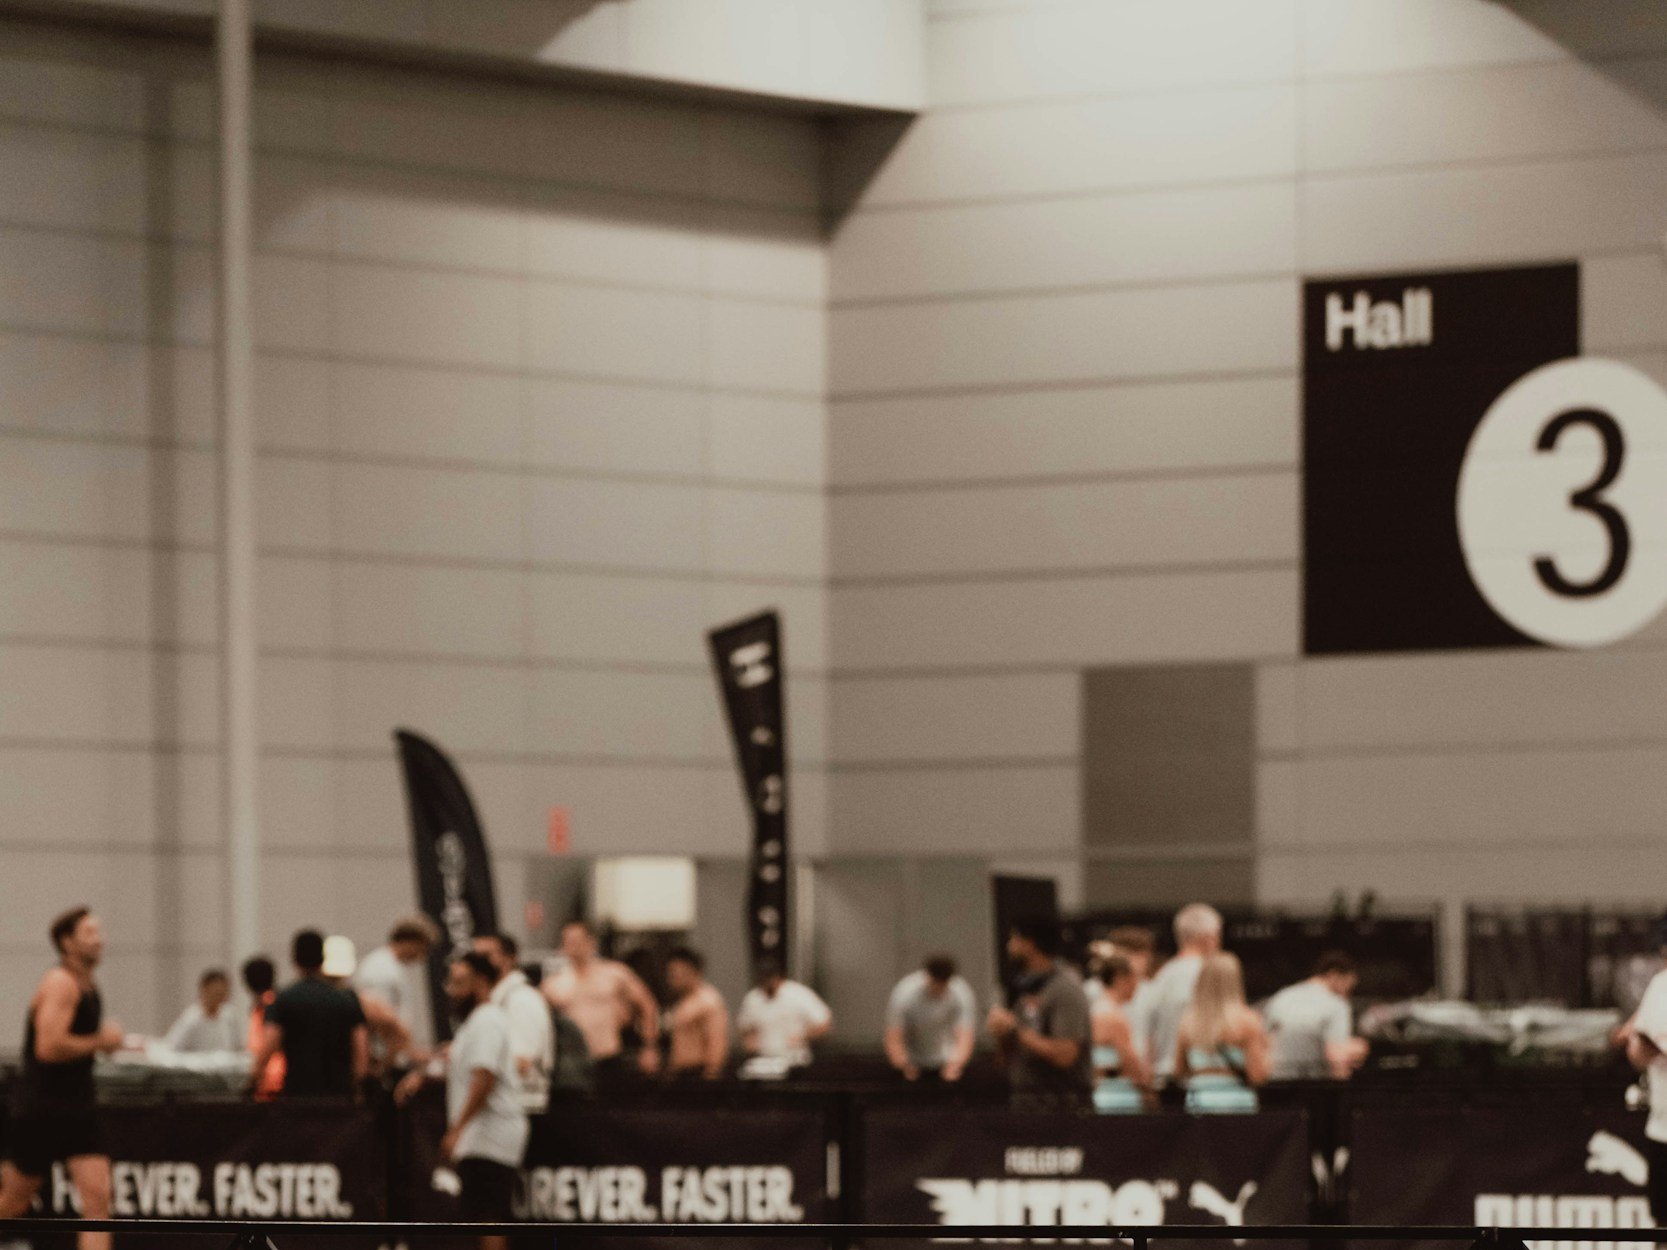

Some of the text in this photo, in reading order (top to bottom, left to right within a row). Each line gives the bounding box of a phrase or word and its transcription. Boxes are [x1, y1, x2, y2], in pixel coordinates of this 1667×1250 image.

[1325, 287, 1433, 350] Hall
[1534, 405, 1633, 601] 3
[214, 1162, 352, 1217] FASTER.
[662, 1165, 803, 1222] FASTER.
